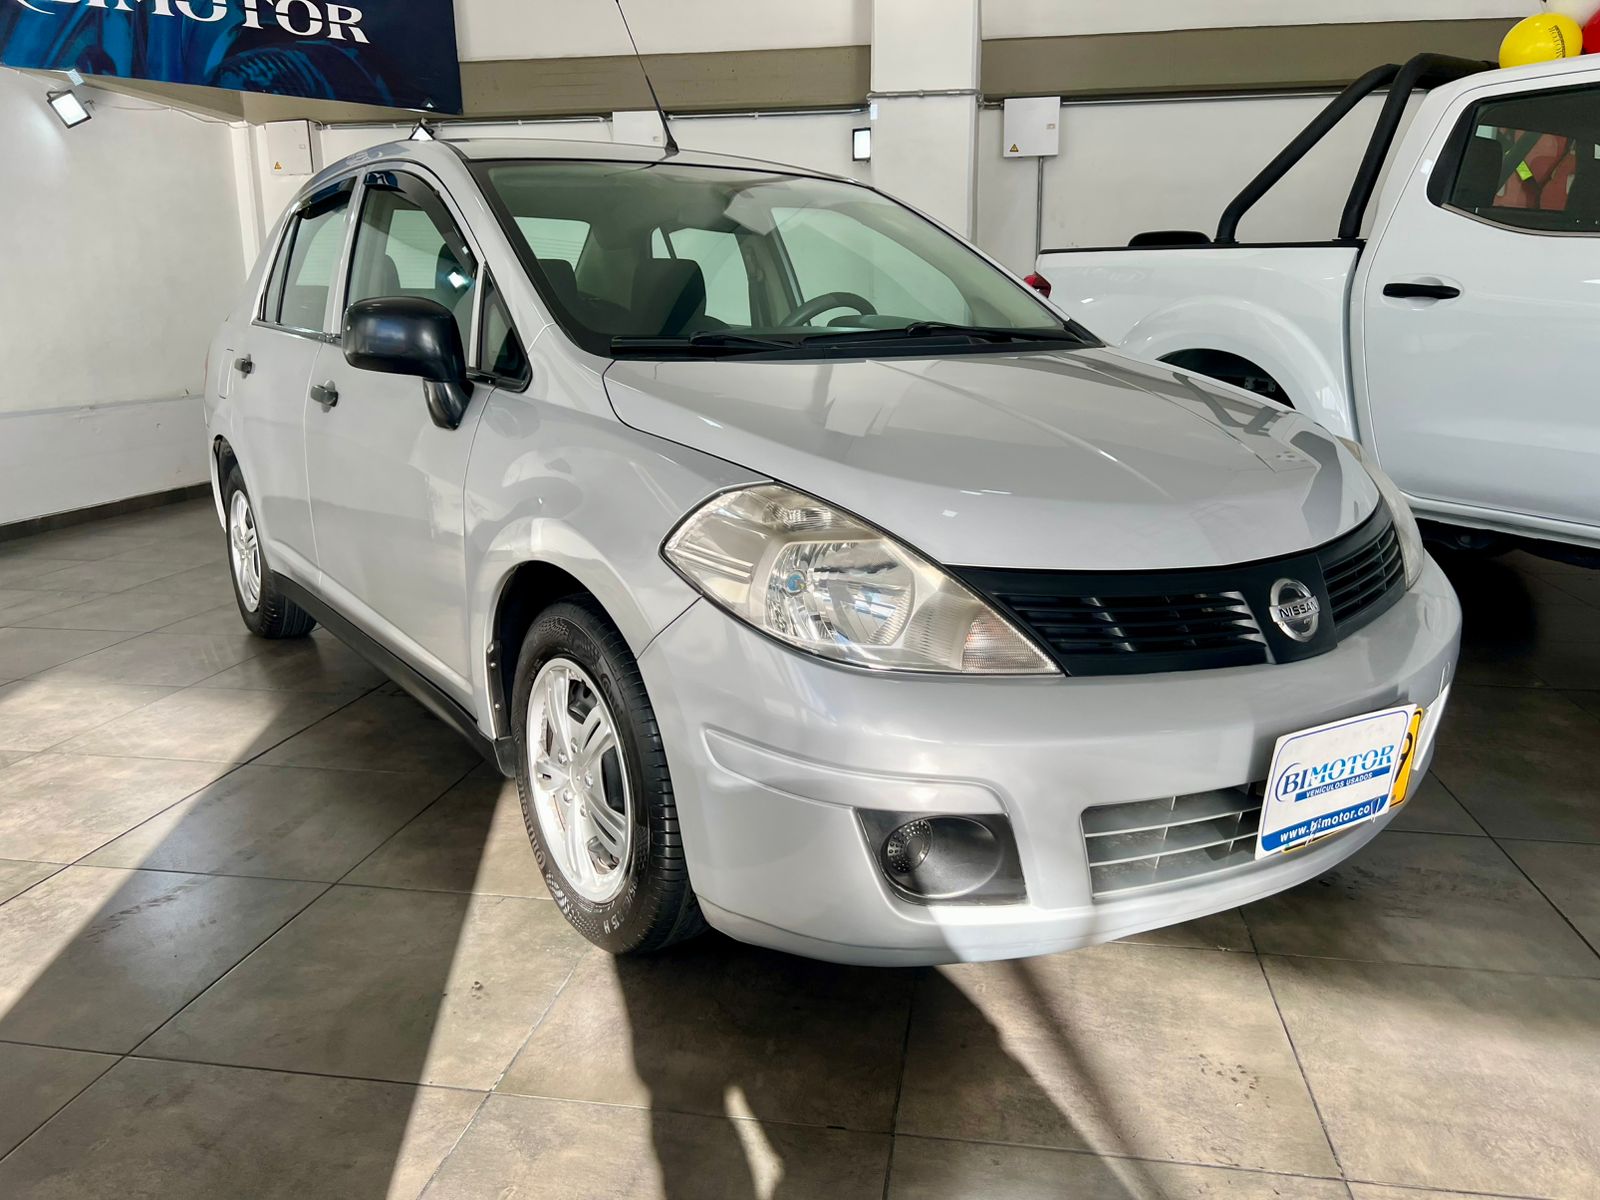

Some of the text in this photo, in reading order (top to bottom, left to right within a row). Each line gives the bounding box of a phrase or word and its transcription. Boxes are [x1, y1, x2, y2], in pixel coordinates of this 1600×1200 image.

[40, 0, 370, 44] OTOR
[1280, 602, 1318, 618] NISSAN
[1281, 745, 1394, 795] BIMOTOR
[1346, 772, 1373, 786] USADOS
[1279, 804, 1371, 843] www.bimotor.co
